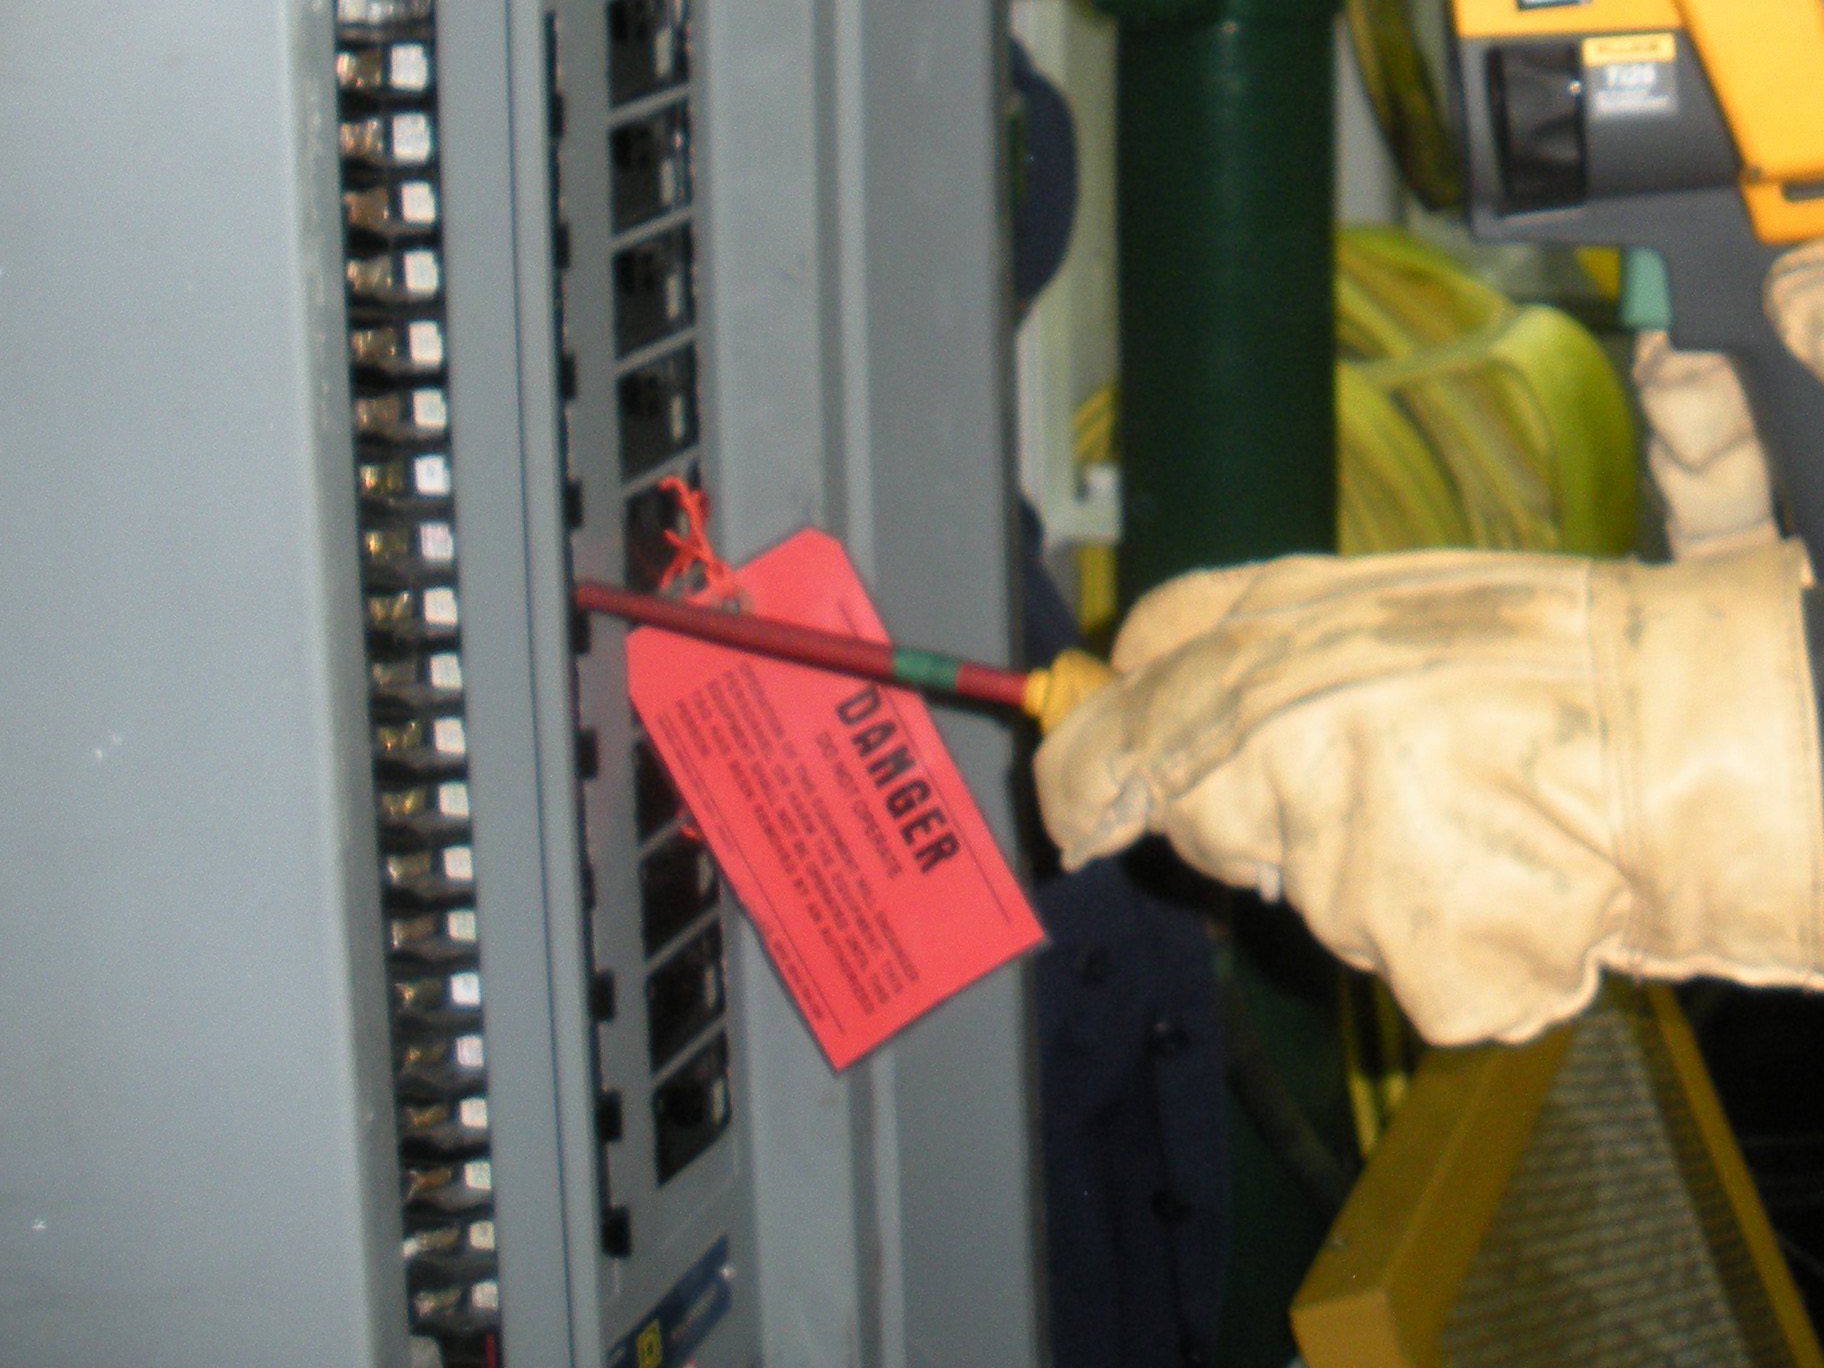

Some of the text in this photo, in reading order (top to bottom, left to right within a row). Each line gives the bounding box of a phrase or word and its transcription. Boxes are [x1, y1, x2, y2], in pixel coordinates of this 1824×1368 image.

[813, 729, 905, 880] DO NOT OPERATE
[835, 684, 960, 874] DANGER
